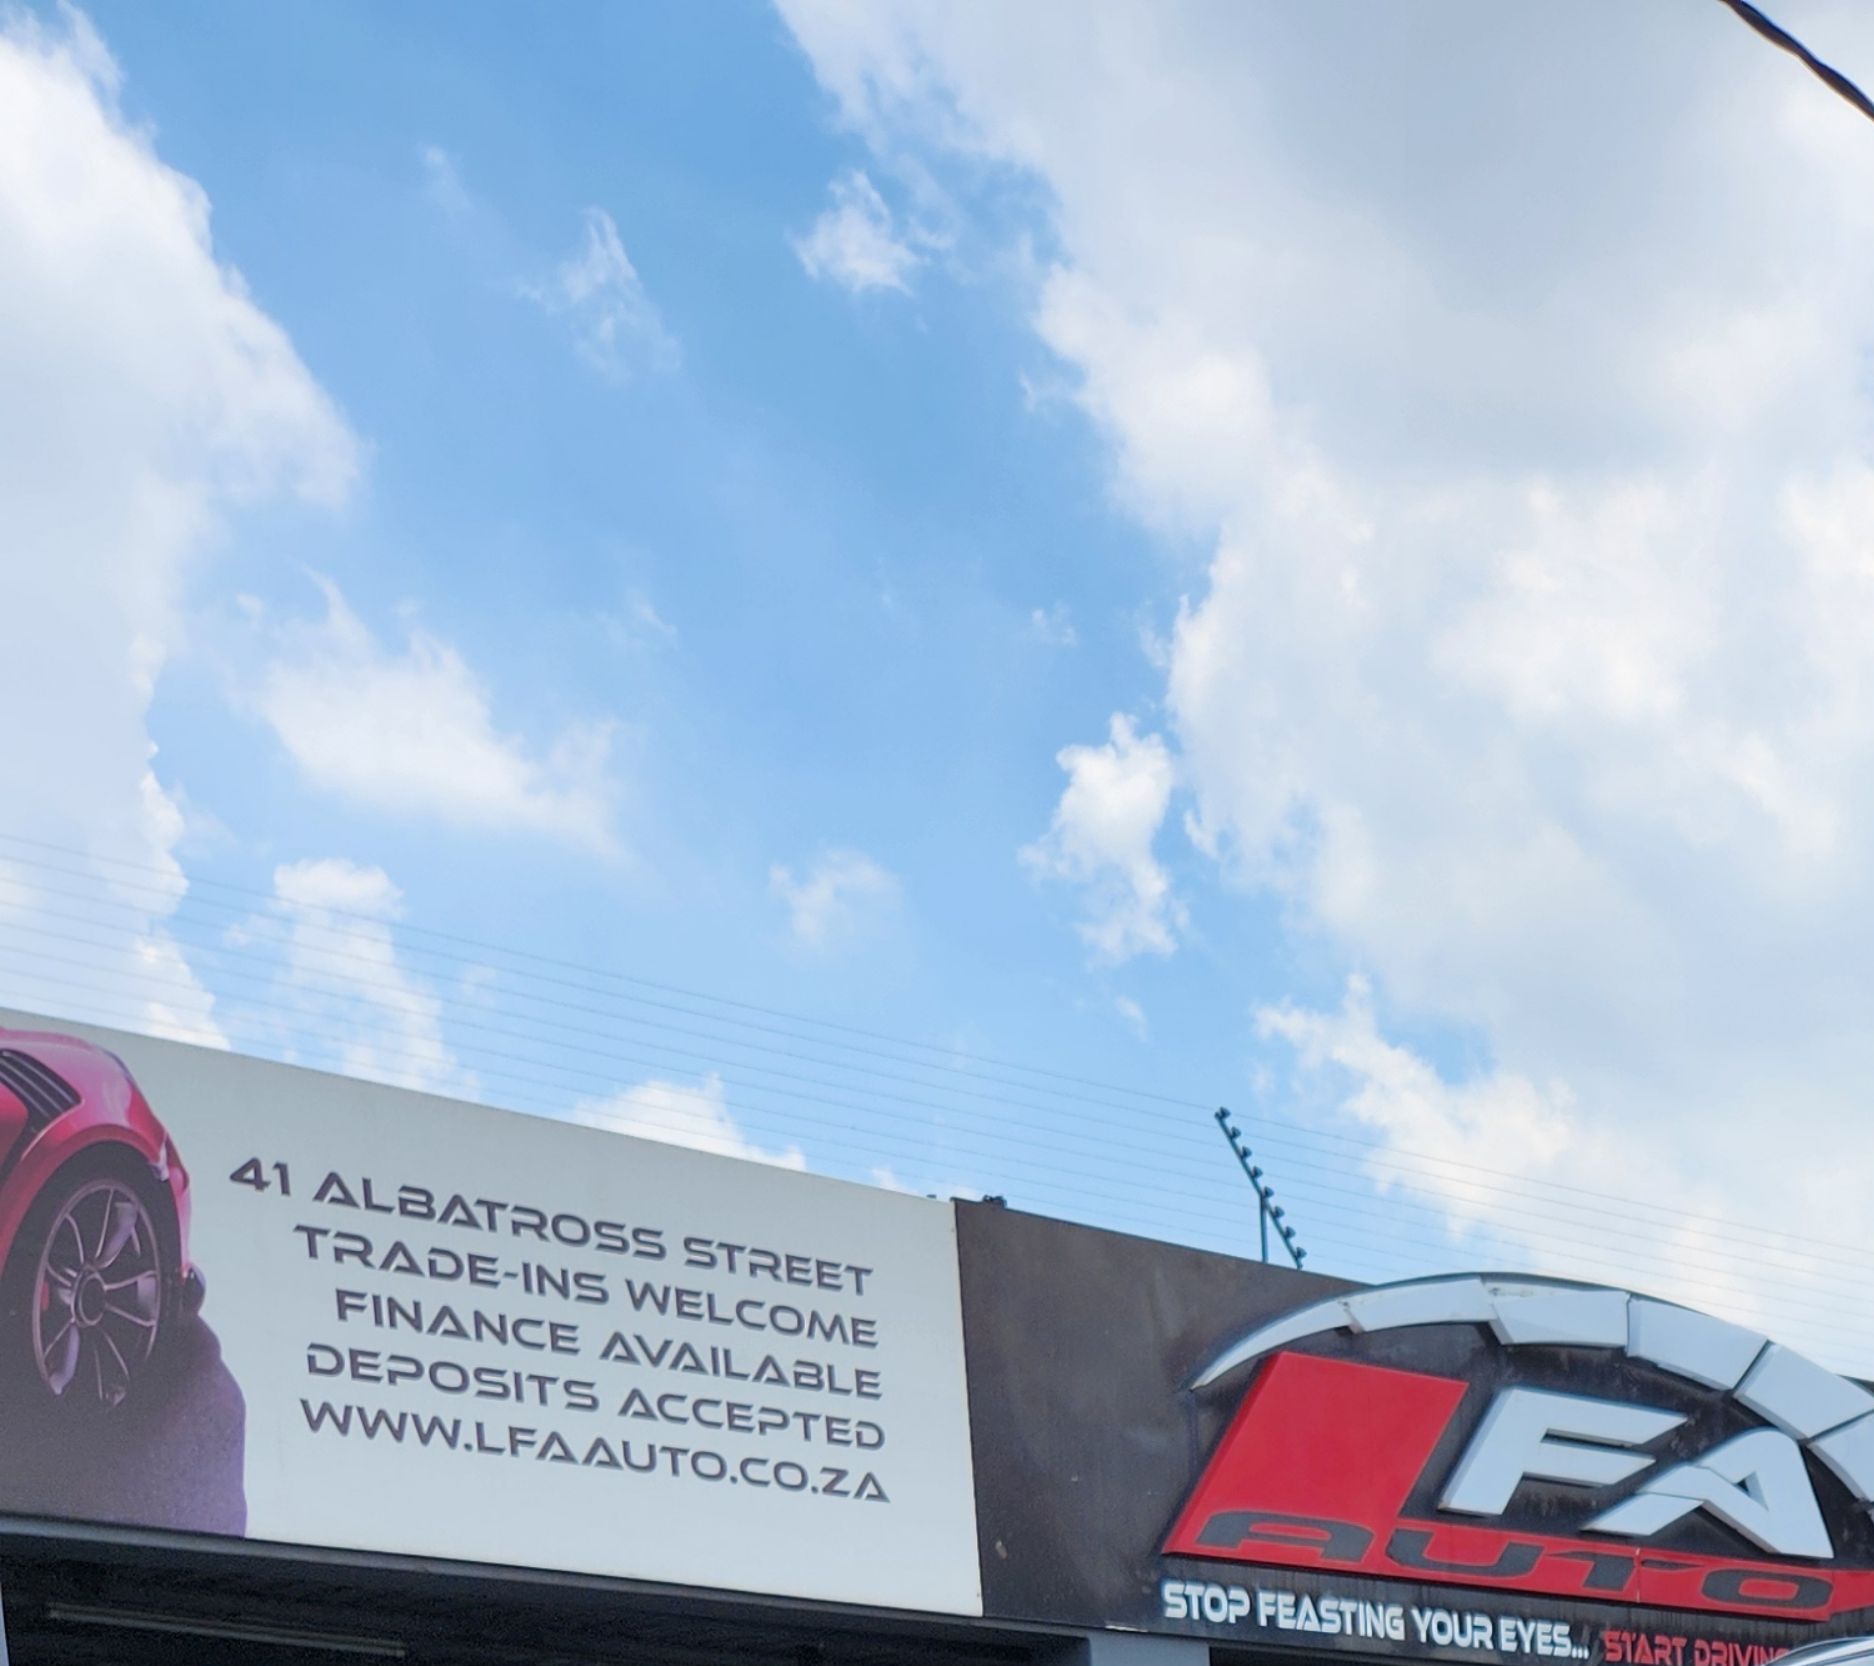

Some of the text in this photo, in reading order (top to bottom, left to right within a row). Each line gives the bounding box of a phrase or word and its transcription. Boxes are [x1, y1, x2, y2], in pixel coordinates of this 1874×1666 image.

[229, 1157, 873, 1296] 41 ALBATROSS STREET
[293, 1224, 879, 1349] TRADE-INS WELCOME
[307, 1342, 885, 1451] DEPOSITS ACCEPTED
[335, 1288, 882, 1401] FINANCE AVAILABLE
[299, 1398, 891, 1503] WWW.LFAAUTO.CO.ZA
[1162, 1351, 1834, 1560] LFA
[1199, 1511, 1832, 1609] AUTO
[1161, 1582, 1250, 1624] STOP
[1257, 1591, 1405, 1641] FEASTING
[1411, 1606, 1494, 1650] YOUR
[1500, 1617, 1590, 1660] EYES...
[1603, 1628, 1687, 1666] START
